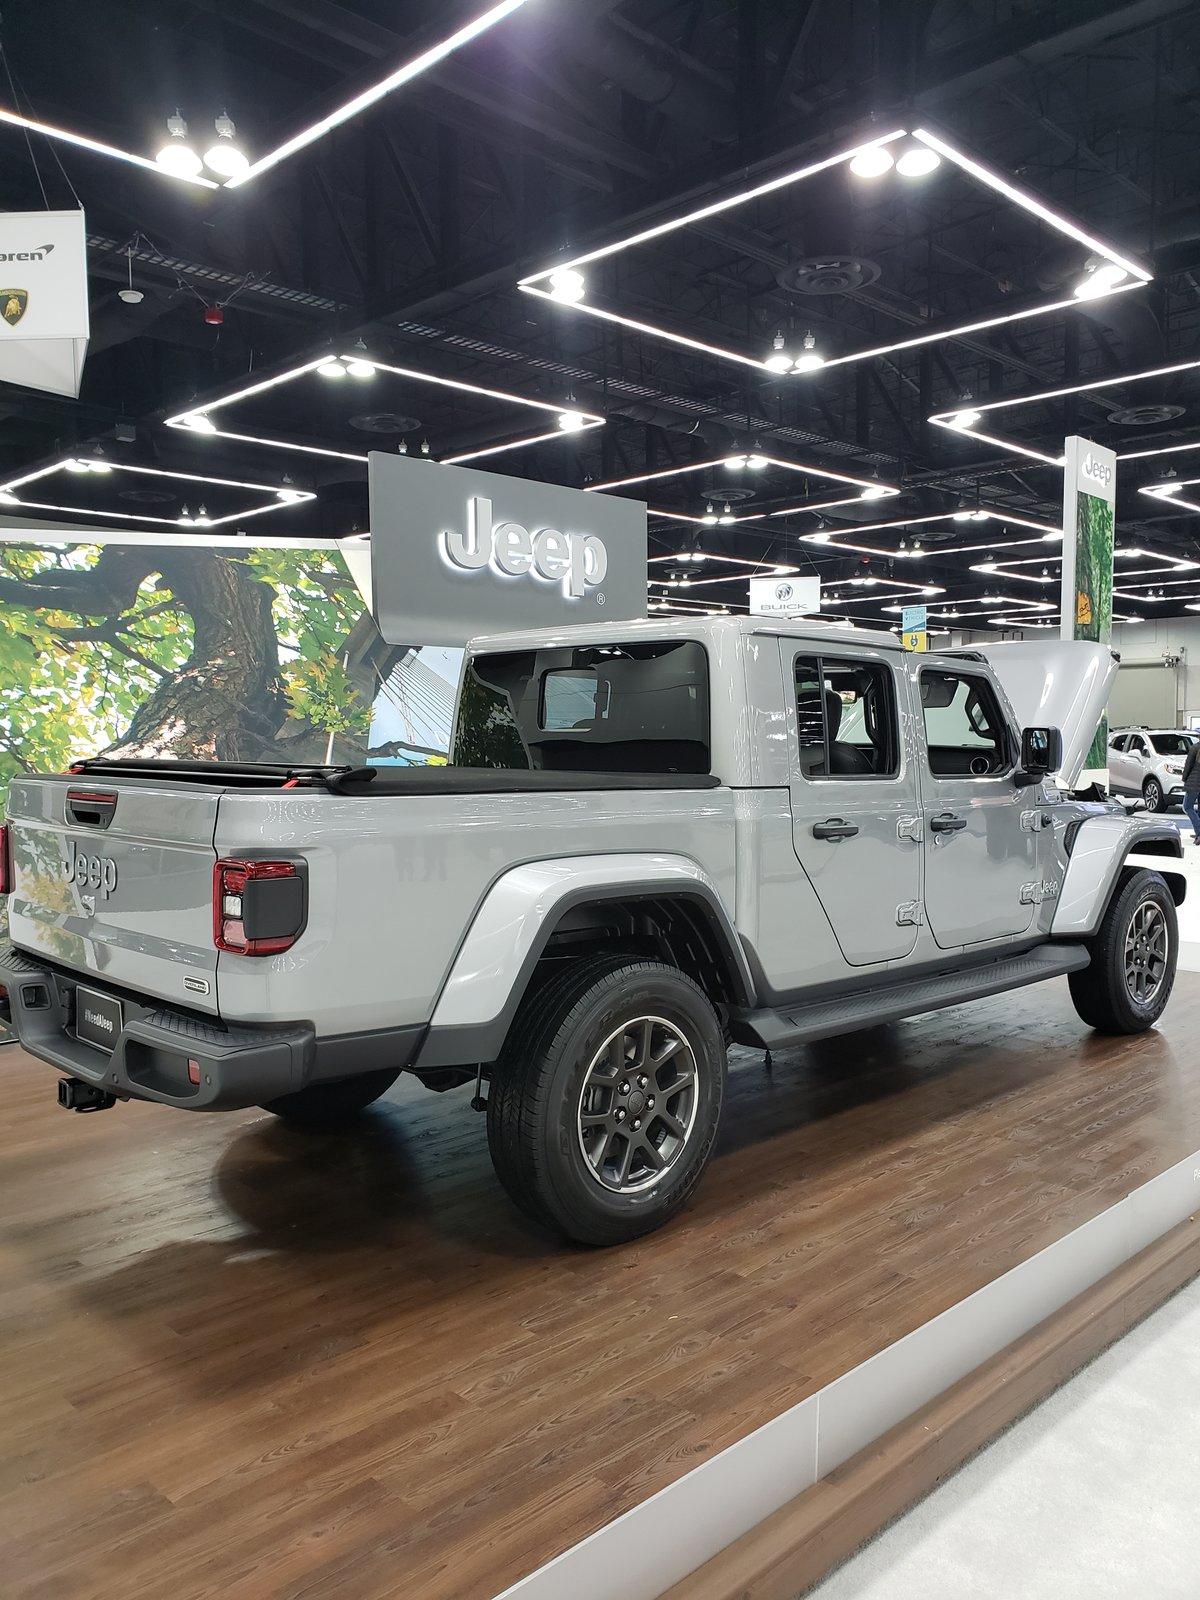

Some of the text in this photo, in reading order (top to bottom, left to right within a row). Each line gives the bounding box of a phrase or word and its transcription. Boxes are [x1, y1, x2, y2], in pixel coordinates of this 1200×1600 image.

[1083, 453, 1111, 486] Jeep
[441, 497, 608, 598] Jeep
[760, 603, 809, 611] BUICK
[60, 841, 118, 900] Jeep
[1040, 879, 1058, 894] Jeep
